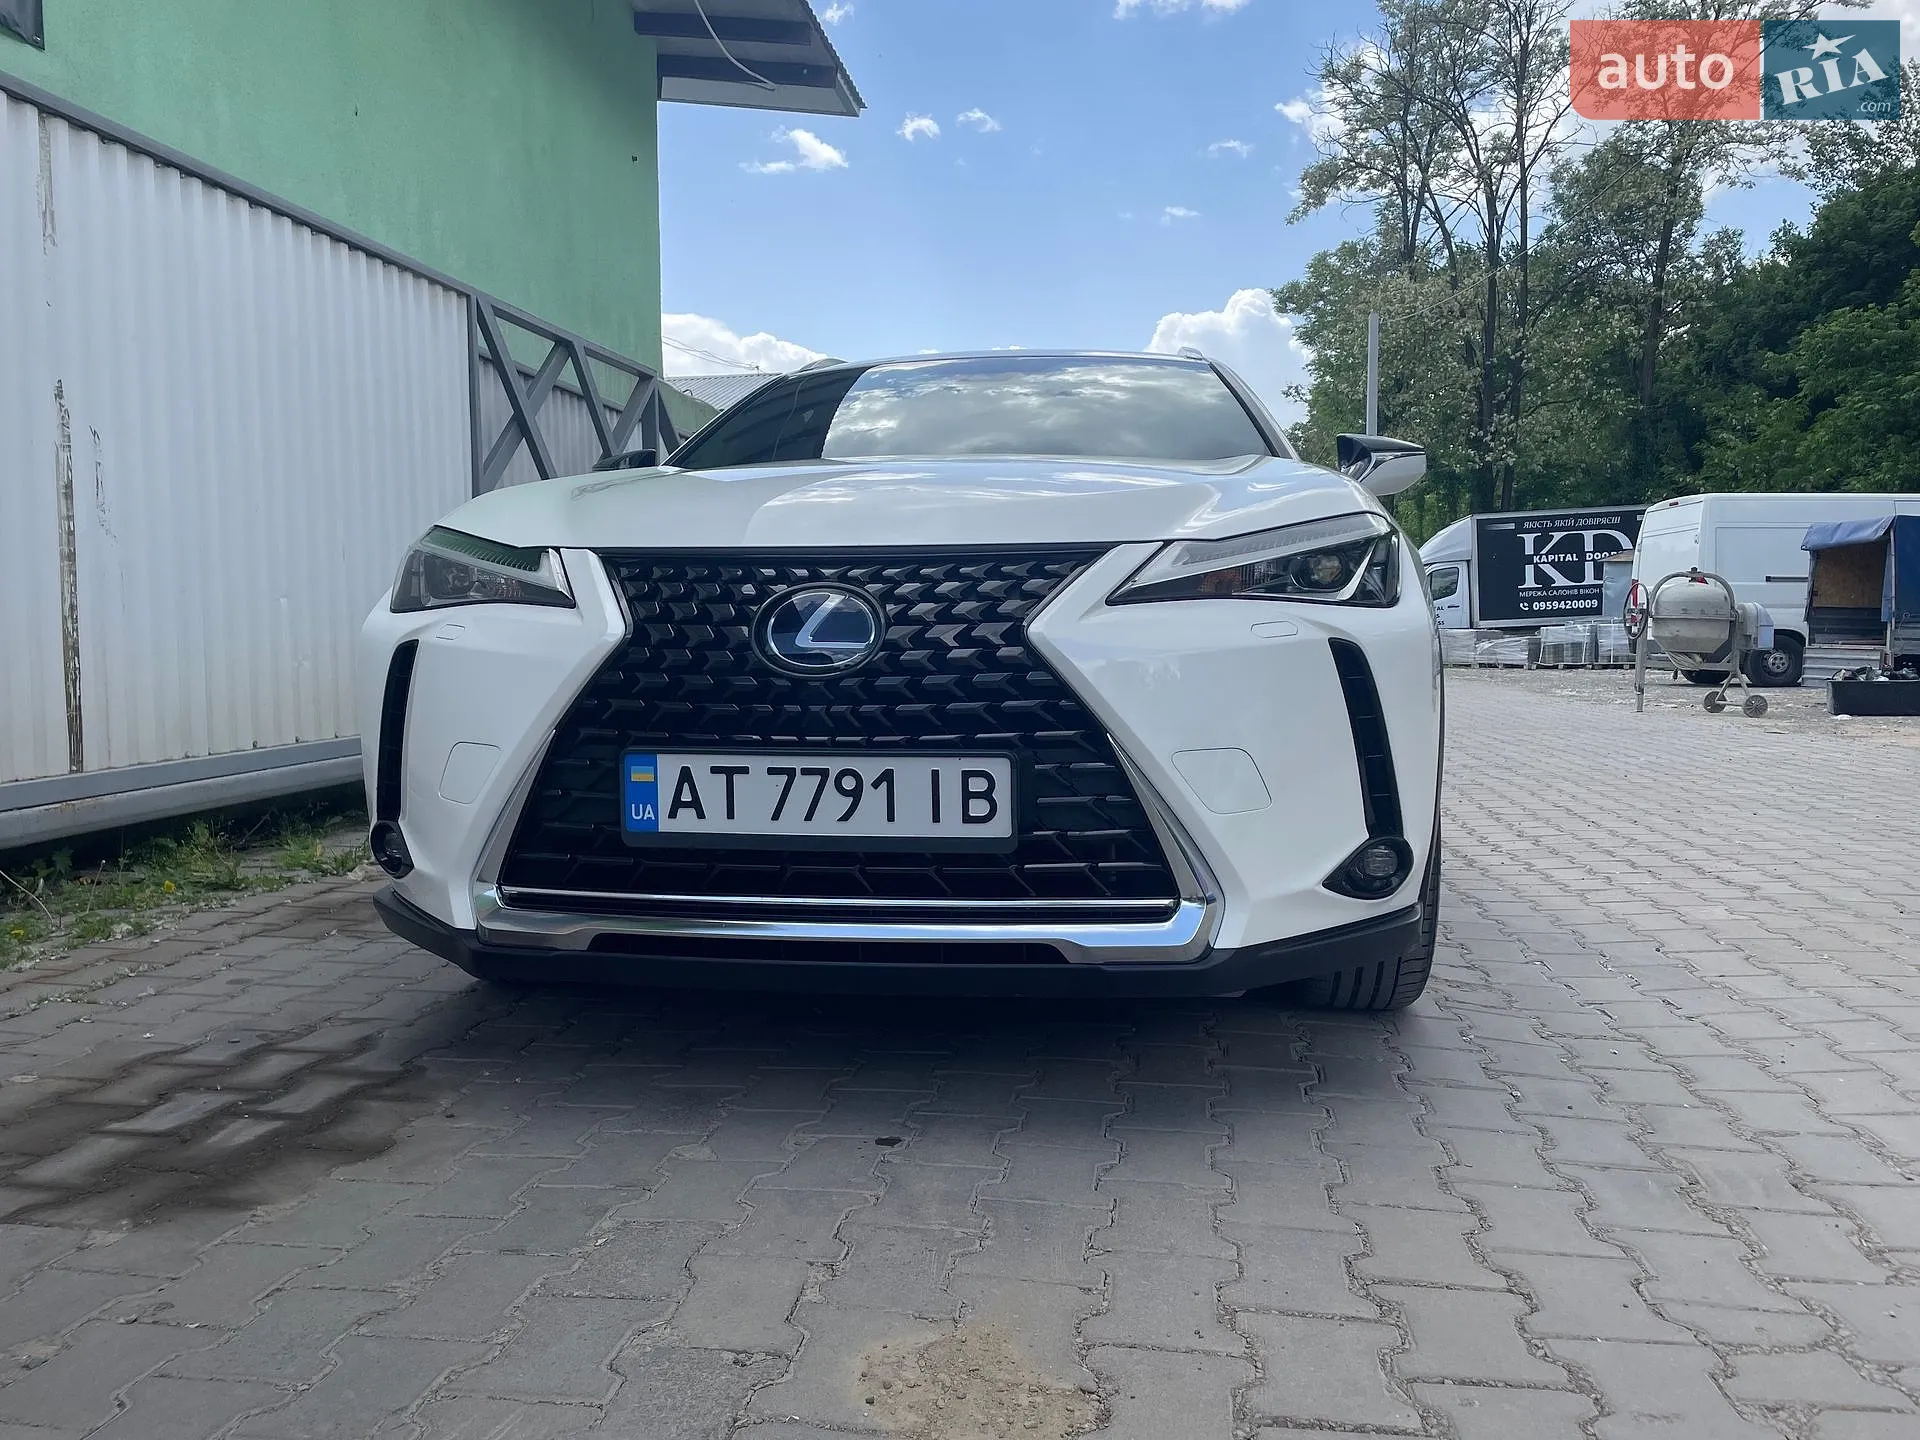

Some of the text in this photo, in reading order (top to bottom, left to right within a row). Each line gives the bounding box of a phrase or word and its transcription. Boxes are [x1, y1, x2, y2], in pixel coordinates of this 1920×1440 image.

[1523, 516, 1621, 529] ЯКІСТЬ ЯКІЙ ДОВІРЯЄШ
[1533, 553, 1579, 563] KAPITAL
[1548, 589, 1579, 597] САЛОНІВ
[1532, 599, 1598, 611] 0959420009
[667, 764, 999, 825] AT 7791 IB
[631, 803, 655, 821] UA
